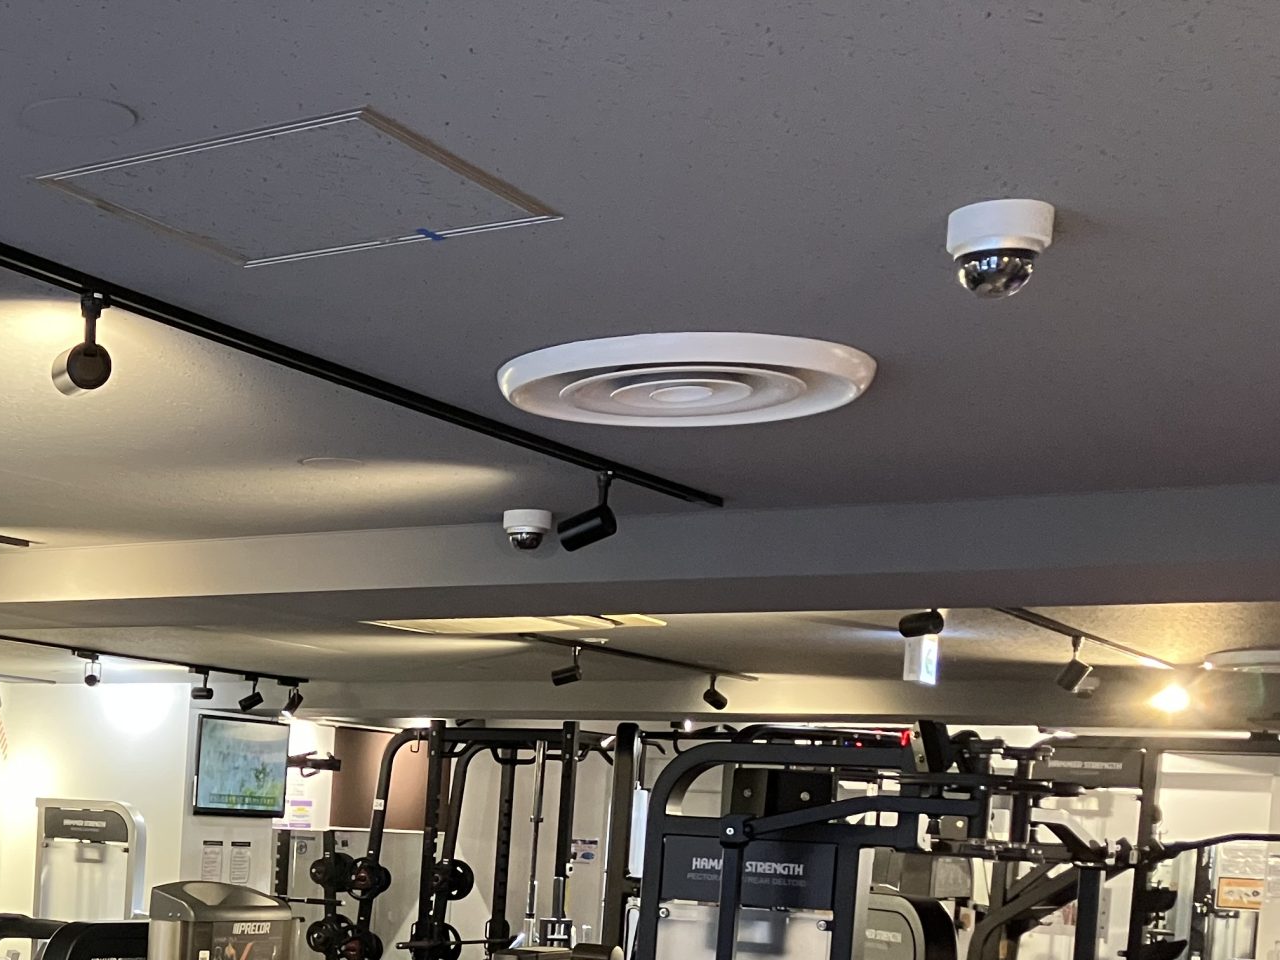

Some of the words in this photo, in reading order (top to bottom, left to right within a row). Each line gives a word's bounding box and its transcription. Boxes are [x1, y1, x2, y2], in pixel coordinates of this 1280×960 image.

[692, 857, 723, 870] HAM
[745, 861, 803, 876] STRENGTH
[232, 922, 271, 935] PRECOR
